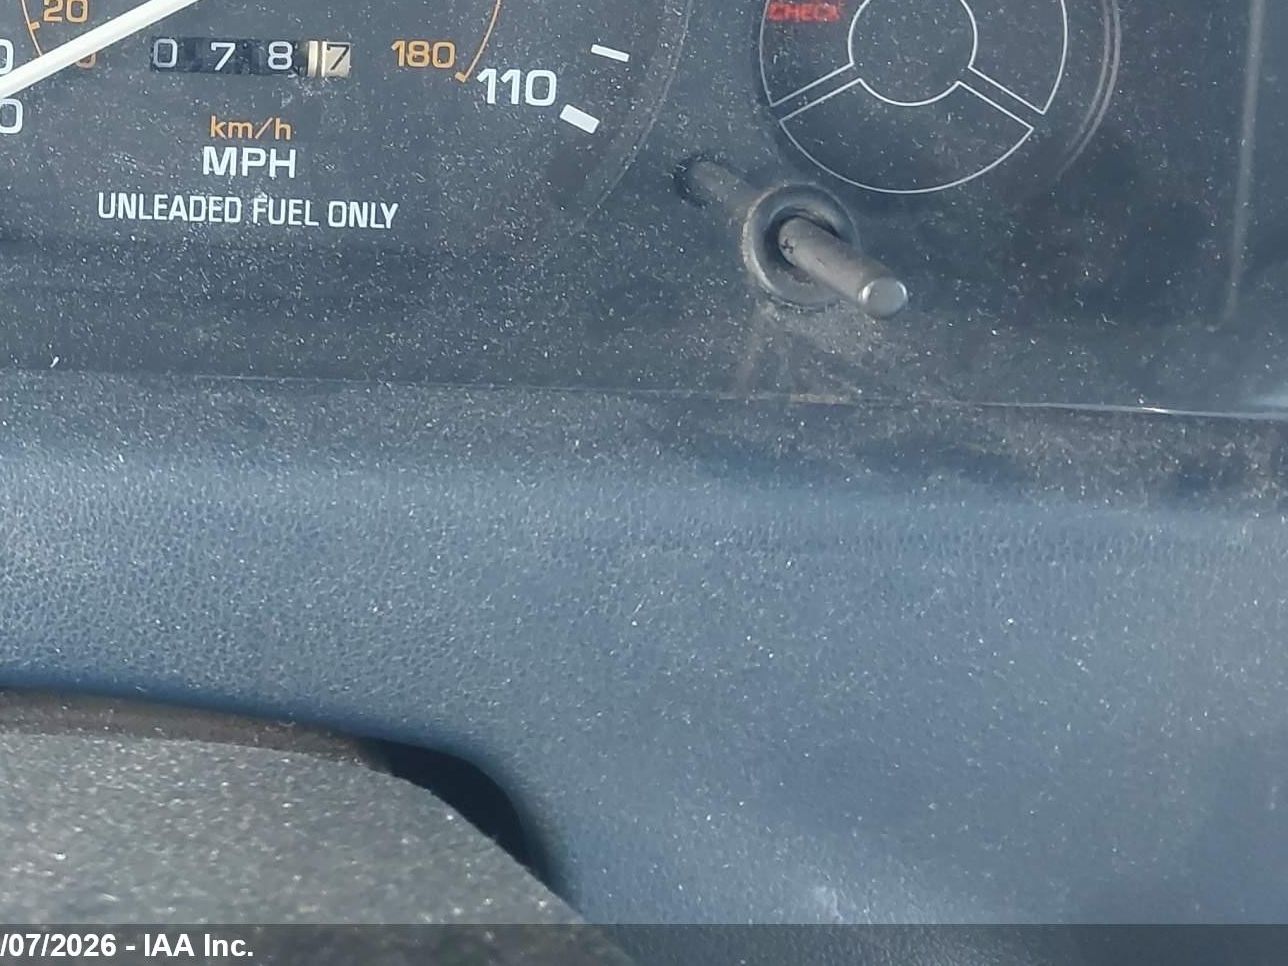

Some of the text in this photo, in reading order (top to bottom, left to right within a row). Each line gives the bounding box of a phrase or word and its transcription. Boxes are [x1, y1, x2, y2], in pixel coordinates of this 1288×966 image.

[768, 2, 840, 22] CHECK
[394, 41, 454, 68] 180
[478, 68, 557, 106] 110
[210, 116, 292, 140] km/h
[202, 145, 296, 179] MPH
[98, 191, 399, 230] UNLEADED FUEL ONLY
